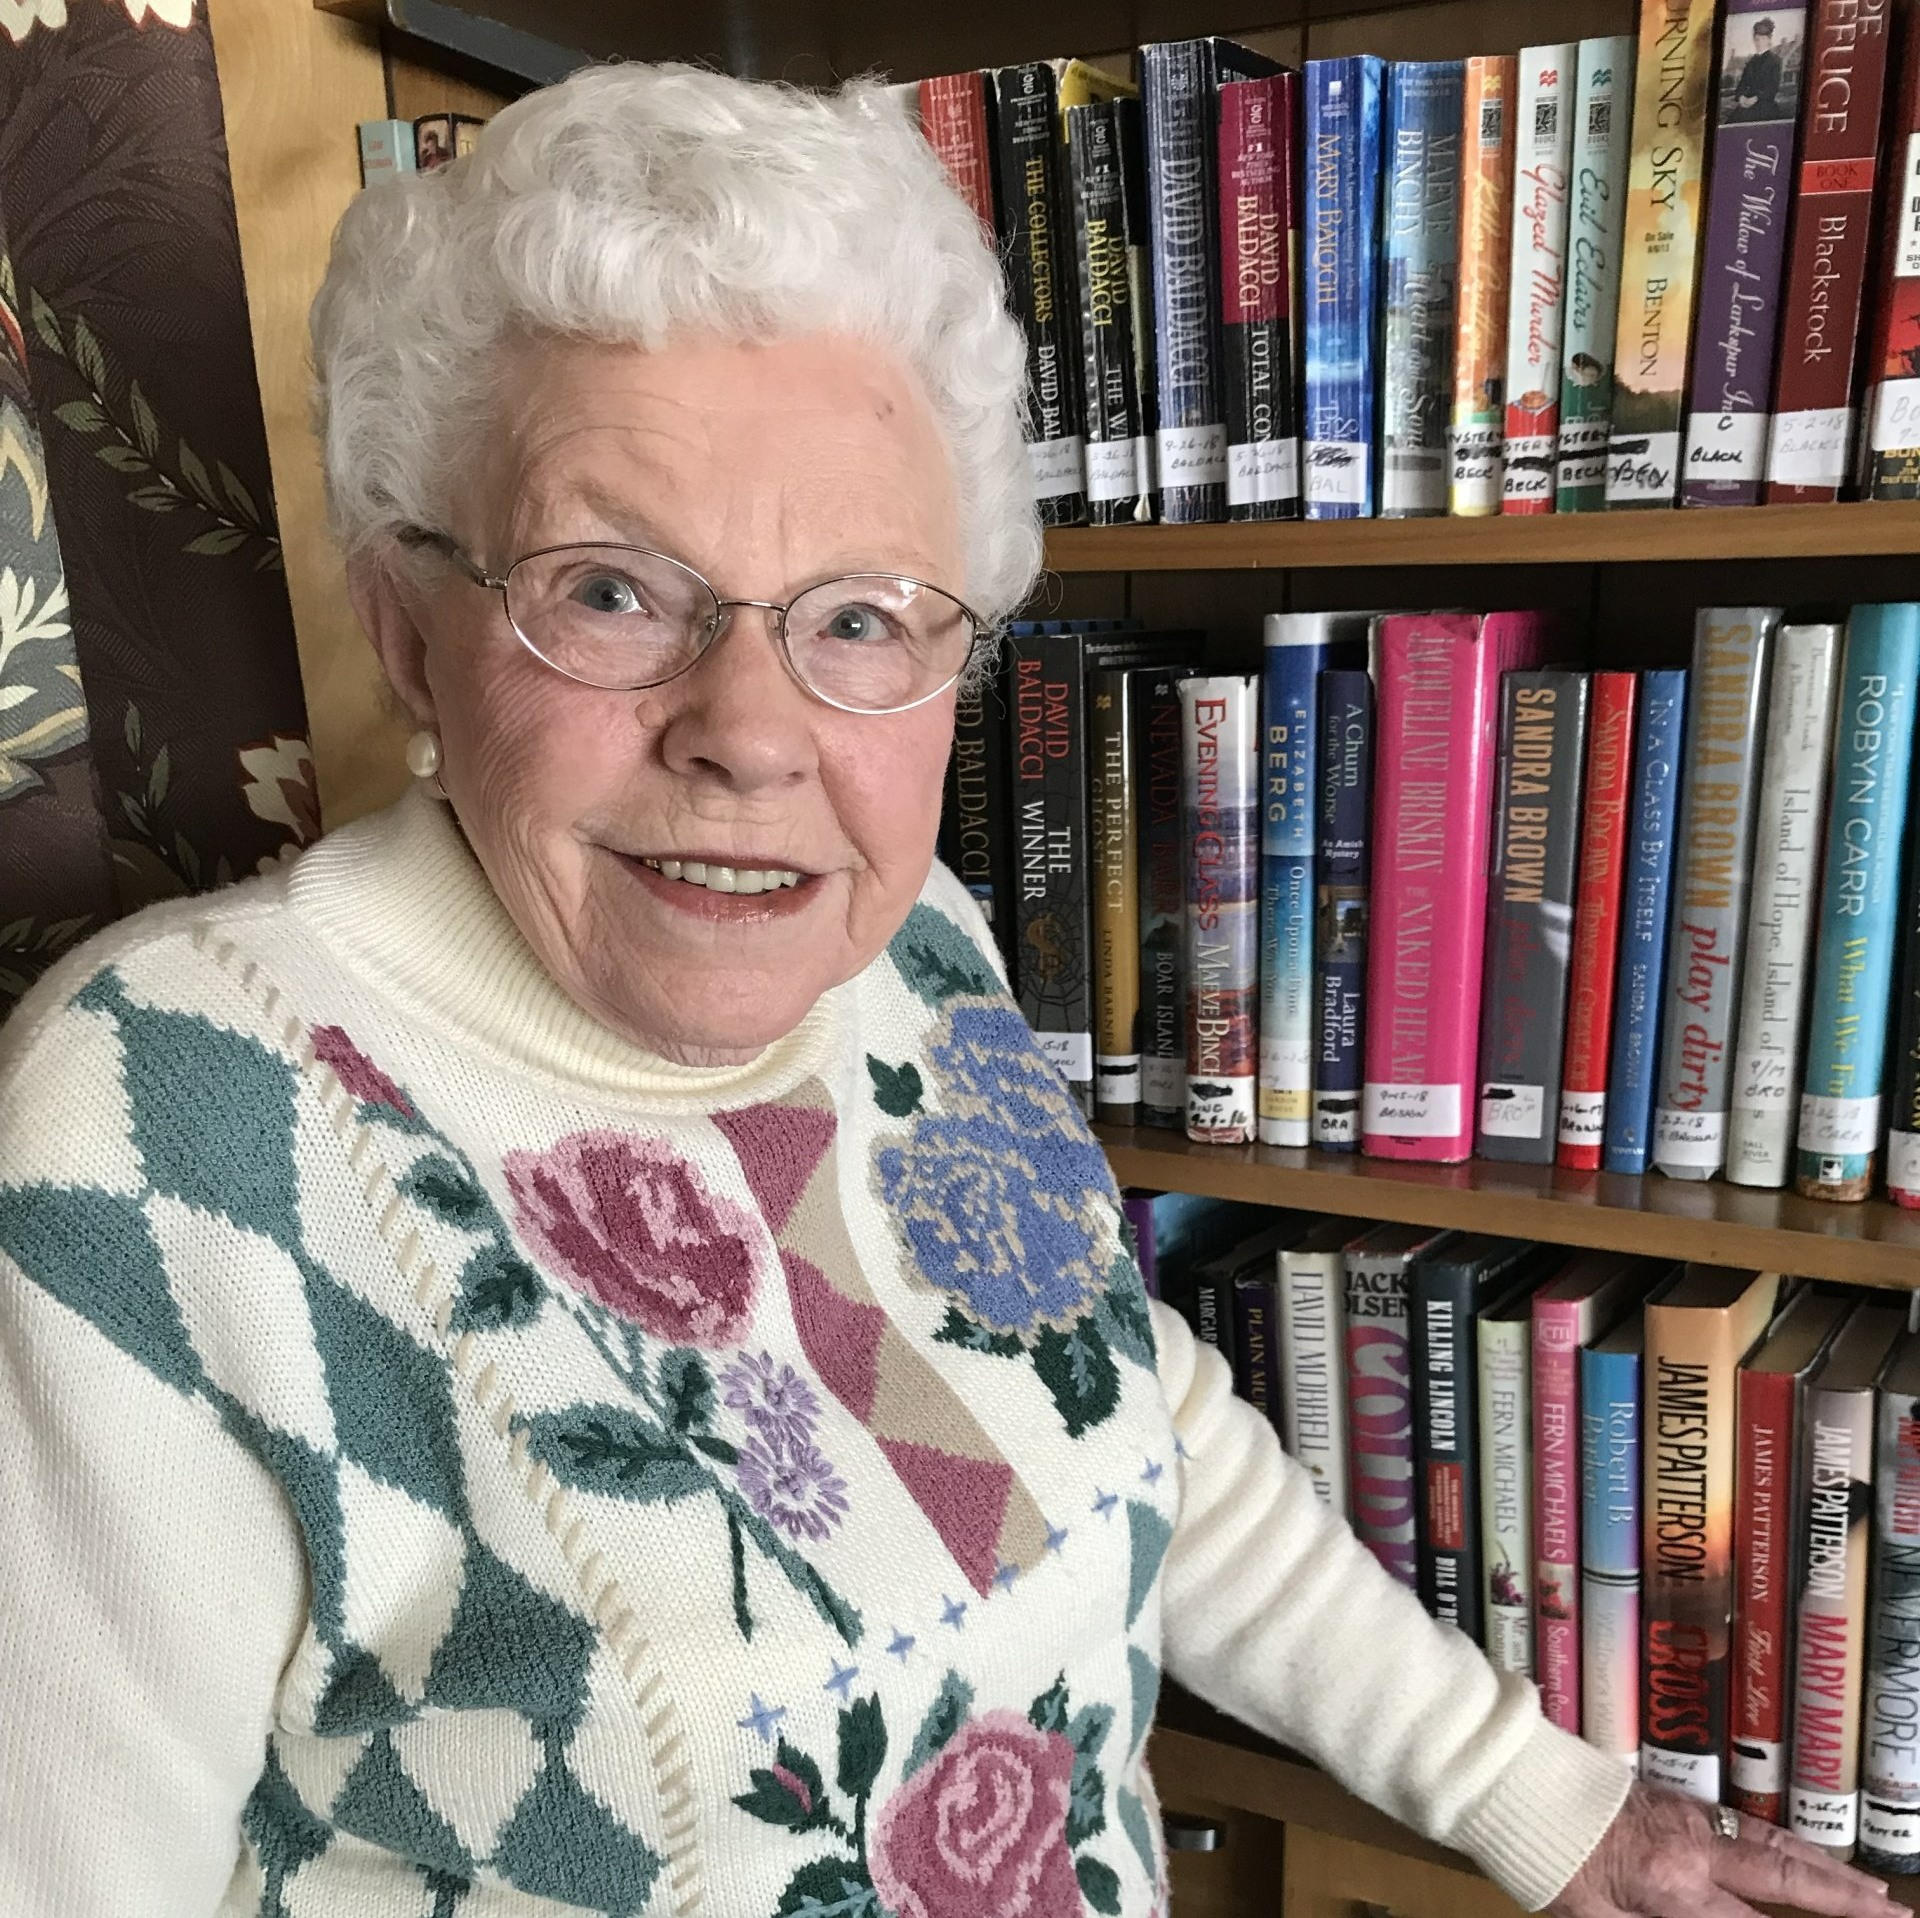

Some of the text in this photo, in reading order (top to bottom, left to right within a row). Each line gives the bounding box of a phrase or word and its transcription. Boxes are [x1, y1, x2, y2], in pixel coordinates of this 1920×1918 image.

[1026, 155, 1046, 197] THE
[1316, 134, 1341, 201] MARY
[1395, 129, 1424, 236] BINCHY
[1425, 132, 1457, 234] MAEVE
[1521, 163, 1568, 260] Glazed
[1579, 167, 1610, 234] Evil
[1650, 146, 1684, 211] SKY
[1816, 162, 1858, 178] BOOK
[1820, 177, 1851, 191] ONE
[1028, 202, 1054, 323] COLLECTORS
[1086, 219, 1113, 327] BALDACCI
[1107, 236, 1129, 305] DAVID
[1161, 156, 1211, 388] DAVID BALDACCI
[1237, 196, 1261, 308] BALDACCI
[1259, 212, 1281, 285] DAVID
[1313, 209, 1344, 304] BALOGH
[1574, 237, 1608, 331] Eclairs
[1718, 138, 1780, 378] The Widow of Larkspur
[1803, 215, 1848, 364] Blackstock
[1527, 261, 1563, 364] Murder
[1640, 278, 1668, 376] BENTON
[1038, 345, 1060, 401] DAVID
[1106, 363, 1124, 406] THE
[1252, 330, 1272, 397] TOTAL
[1690, 446, 1744, 463] BLACK
[1717, 414, 1734, 431] C
[1308, 475, 1350, 493] BAL
[1454, 466, 1494, 480] BECK
[1504, 477, 1548, 493] BECK
[1562, 466, 1606, 481] BECK
[1017, 660, 1044, 780] BALDACCI
[1044, 682, 1070, 759] DAVID
[1151, 704, 1180, 825] NEVADA
[1344, 703, 1365, 788] A Churn
[1396, 631, 1456, 875] JACQUELINE BRISKIN
[1685, 623, 1754, 908] SANDRA BROWN
[957, 738, 991, 879] BALDACCI
[1193, 697, 1226, 932] EVENING CLASS
[1268, 725, 1288, 822] BERG
[1292, 708, 1307, 838] ELIZABETH
[1324, 714, 1342, 825] for the Worse
[1504, 688, 1557, 904] SANDRA BROWN
[1837, 674, 1888, 917] ROBYN CARR
[1022, 800, 1047, 901] WINNER
[1048, 826, 1072, 874] THE
[1091, 777, 1104, 868] GHOST
[1105, 731, 1124, 914] THE PERFECT
[1635, 698, 1674, 943] IN A CLASS BY ITSELF
[1779, 788, 1811, 853] Island
[1286, 866, 1306, 909] Once
[1776, 862, 1800, 882] of
[1156, 951, 1174, 996] BOAR
[1196, 940, 1230, 1015] MAEVE
[1283, 914, 1305, 958] Upon
[1393, 903, 1433, 999] NAKED
[1102, 930, 1114, 1049] LINDA BARNES
[1322, 975, 1343, 1064] Bradford
[1341, 992, 1361, 1049] Laura
[1668, 921, 1730, 1111] play dirty
[1762, 961, 1794, 1022] Island
[1834, 937, 1868, 1054] What We
[1290, 1271, 1326, 1342] DAVID
[1345, 1271, 1410, 1294] JACK
[1247, 1307, 1265, 1364] PLAIN
[1426, 1300, 1455, 1373] KILLING
[1294, 1351, 1330, 1452] MORRELL
[1428, 1379, 1456, 1452] LINCOLN
[1492, 1389, 1515, 1437] FERN
[1542, 1402, 1566, 1450] FERN
[1493, 1442, 1517, 1535] MICHAELS
[1583, 1413, 1607, 1505] Parker
[1606, 1401, 1639, 1528] Robert B.
[1656, 1355, 1709, 1582] JAMES PATTERSON
[1543, 1459, 1567, 1560] MICHAELS
[1751, 1423, 1776, 1602] JAMES PATTERSON
[1808, 1420, 1852, 1600] JAMES PATTERSON
[1435, 1555, 1458, 1588] BILL
[1546, 1624, 1570, 1692] Southern
[1648, 1620, 1710, 1746] CROSS
[1872, 1540, 1920, 1760] NEVERMORE
[1796, 1613, 1849, 1791] MARY MARY
